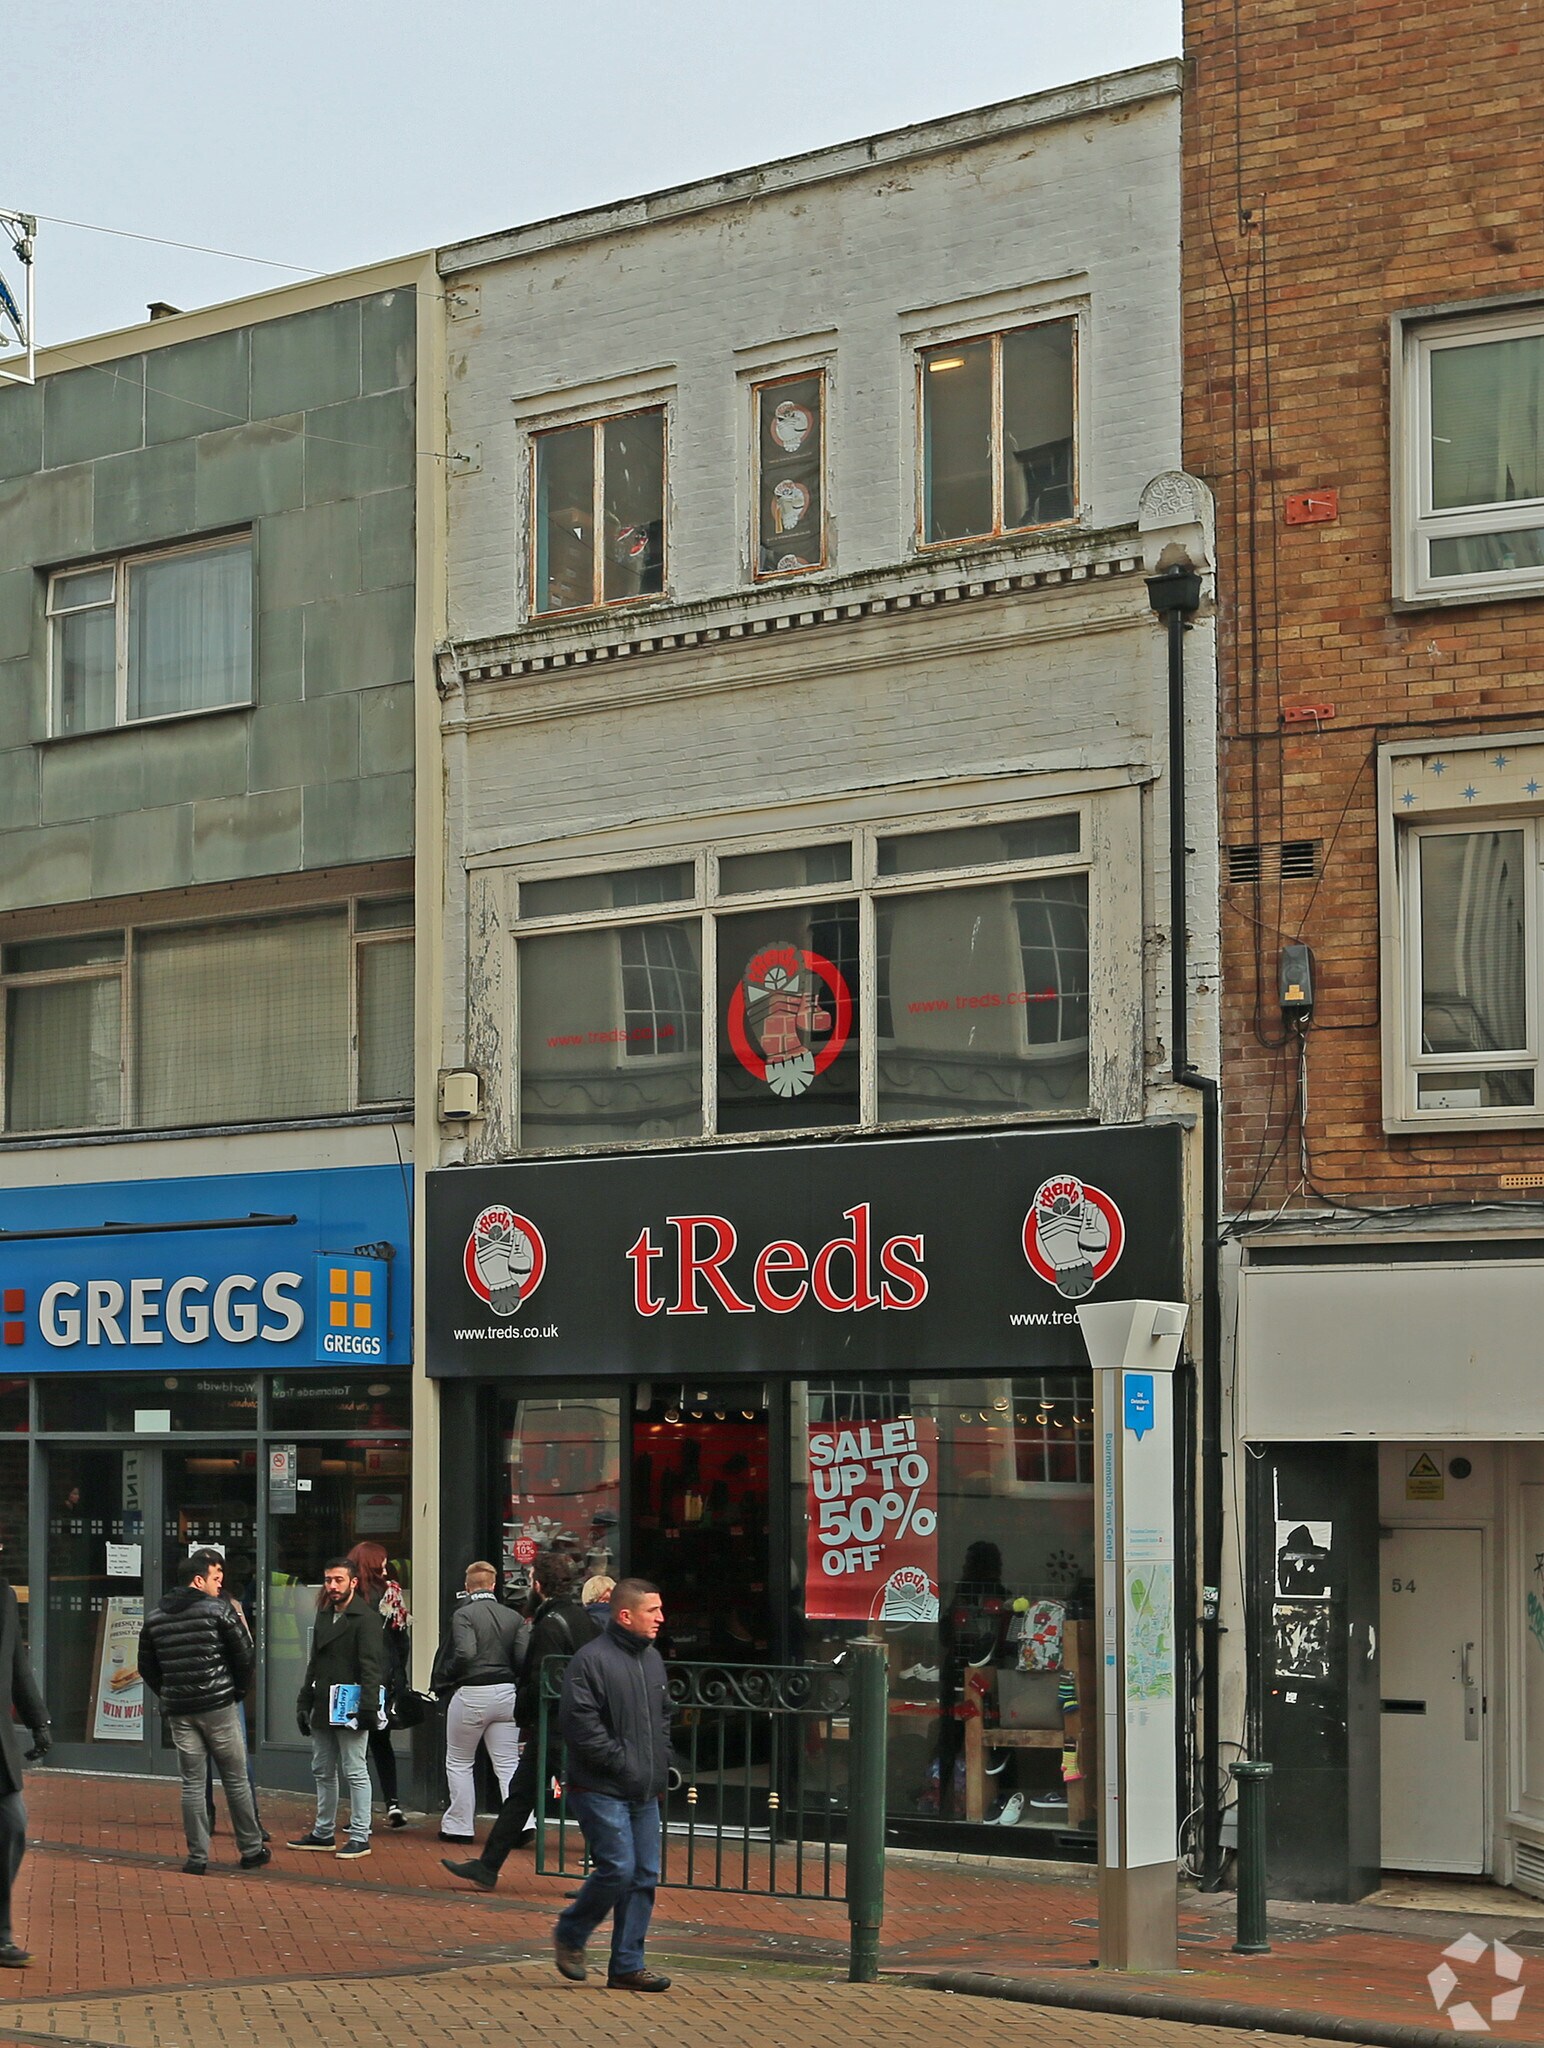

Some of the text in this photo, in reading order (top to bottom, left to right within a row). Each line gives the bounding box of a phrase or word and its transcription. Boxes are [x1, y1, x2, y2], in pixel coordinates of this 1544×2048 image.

[1039, 1180, 1081, 1209] tReds
[478, 1210, 512, 1235] tReds
[625, 1201, 930, 1318] tReds
[38, 1271, 305, 1347] GREGGS
[323, 1333, 381, 1355] GREGGS
[453, 1323, 559, 1340] www.treds.co.uk
[809, 1419, 917, 1467] SALE!
[811, 1453, 929, 1501] UP TO
[1105, 1433, 1114, 1559] Bournemouth Town Centre
[820, 1488, 938, 1547] 50%
[516, 1545, 535, 1555] 10%
[891, 1571, 926, 1595] tReds
[1392, 1578, 1417, 1593] 54
[103, 1700, 144, 1718] WIN WIN
[338, 1688, 349, 1721] Headway
